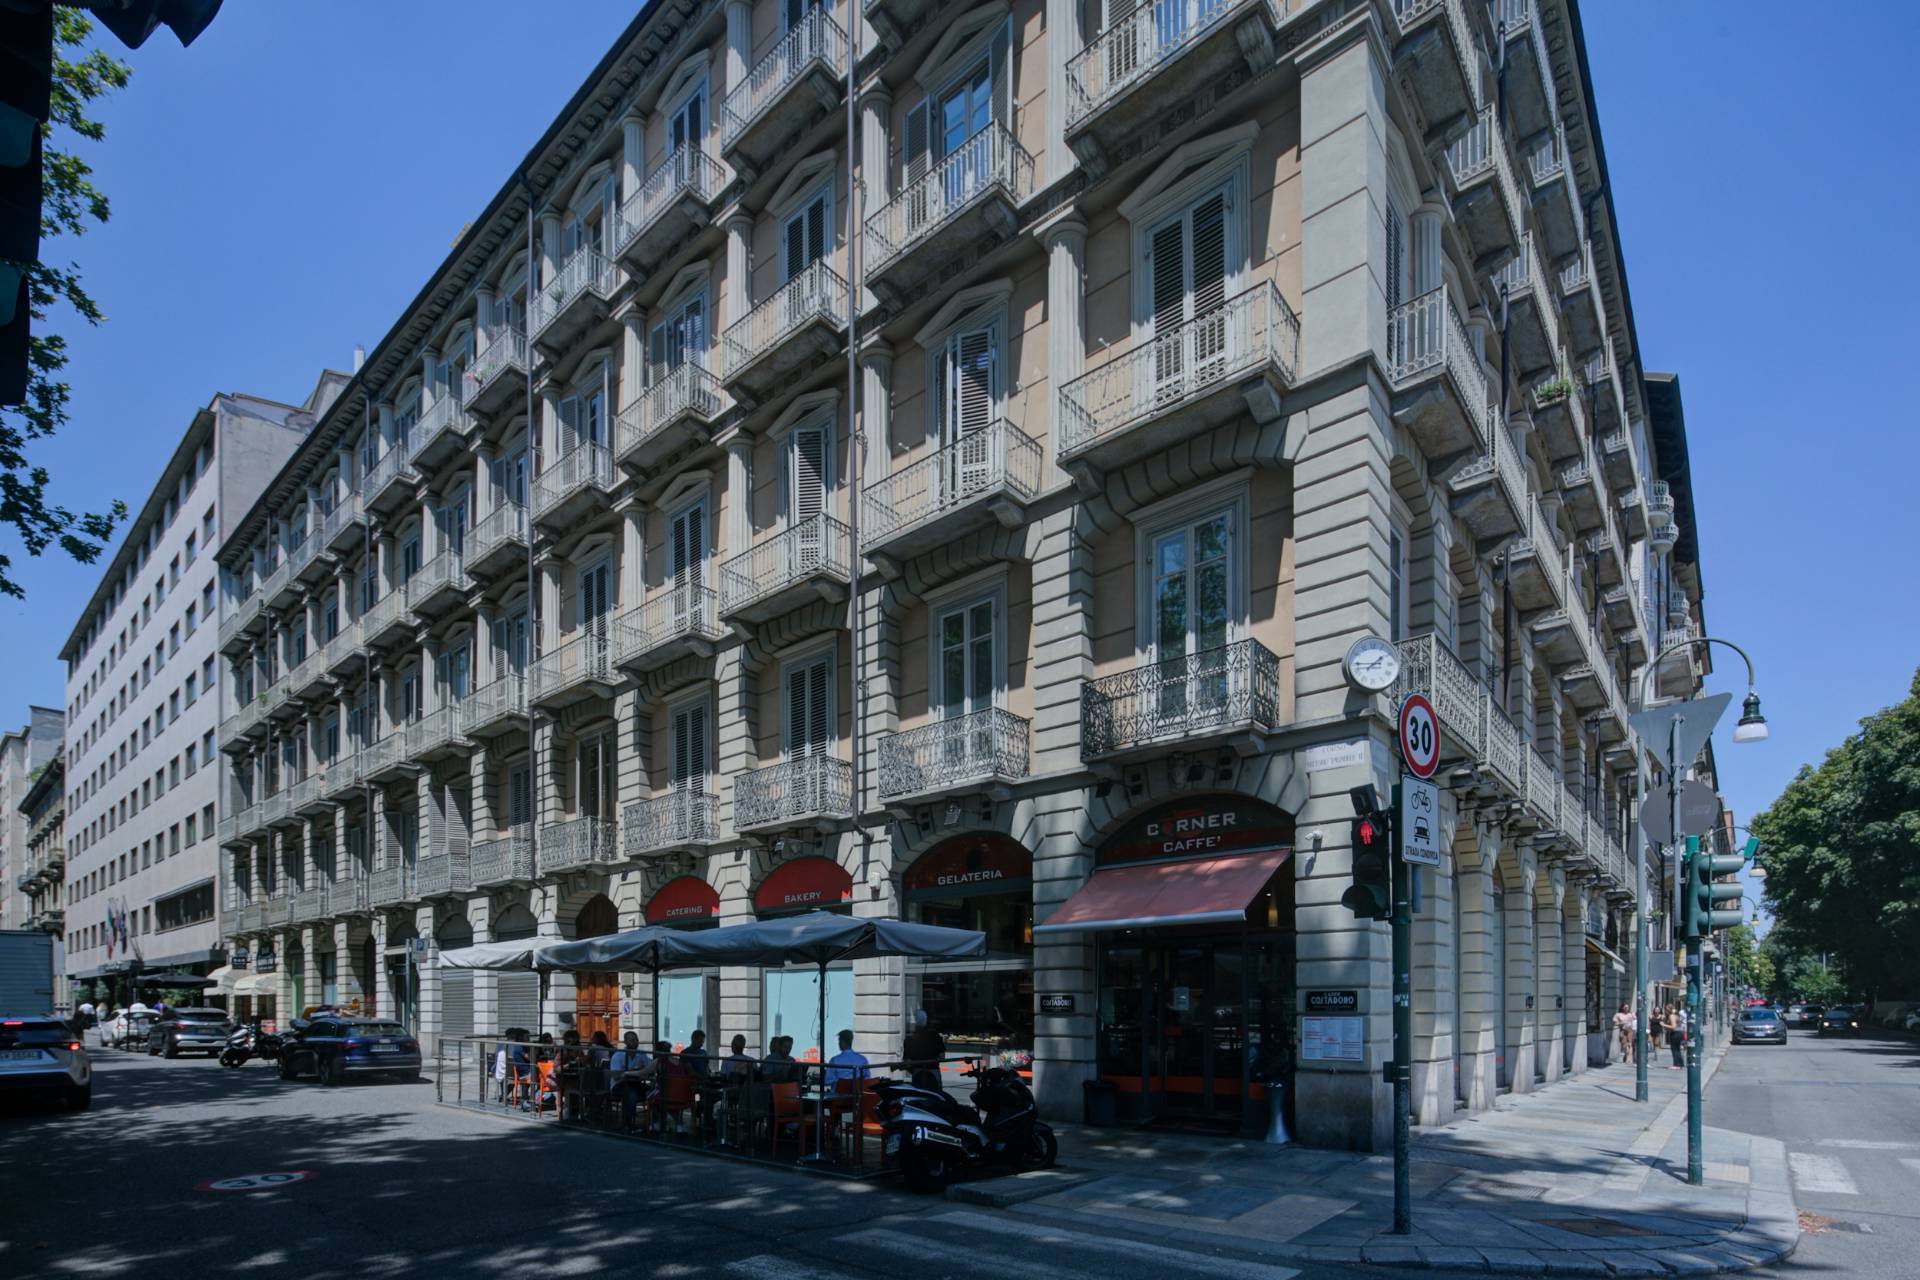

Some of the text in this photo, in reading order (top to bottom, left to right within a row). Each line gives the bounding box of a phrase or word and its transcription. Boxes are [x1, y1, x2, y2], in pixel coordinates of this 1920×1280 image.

[1410, 716, 1432, 756] 30
[1147, 812, 1237, 836] CRNER
[937, 870, 1003, 886] GELATERIA
[784, 891, 822, 903] BAKERY
[666, 905, 703, 917] CATERING
[221, 1174, 295, 1188] 30
